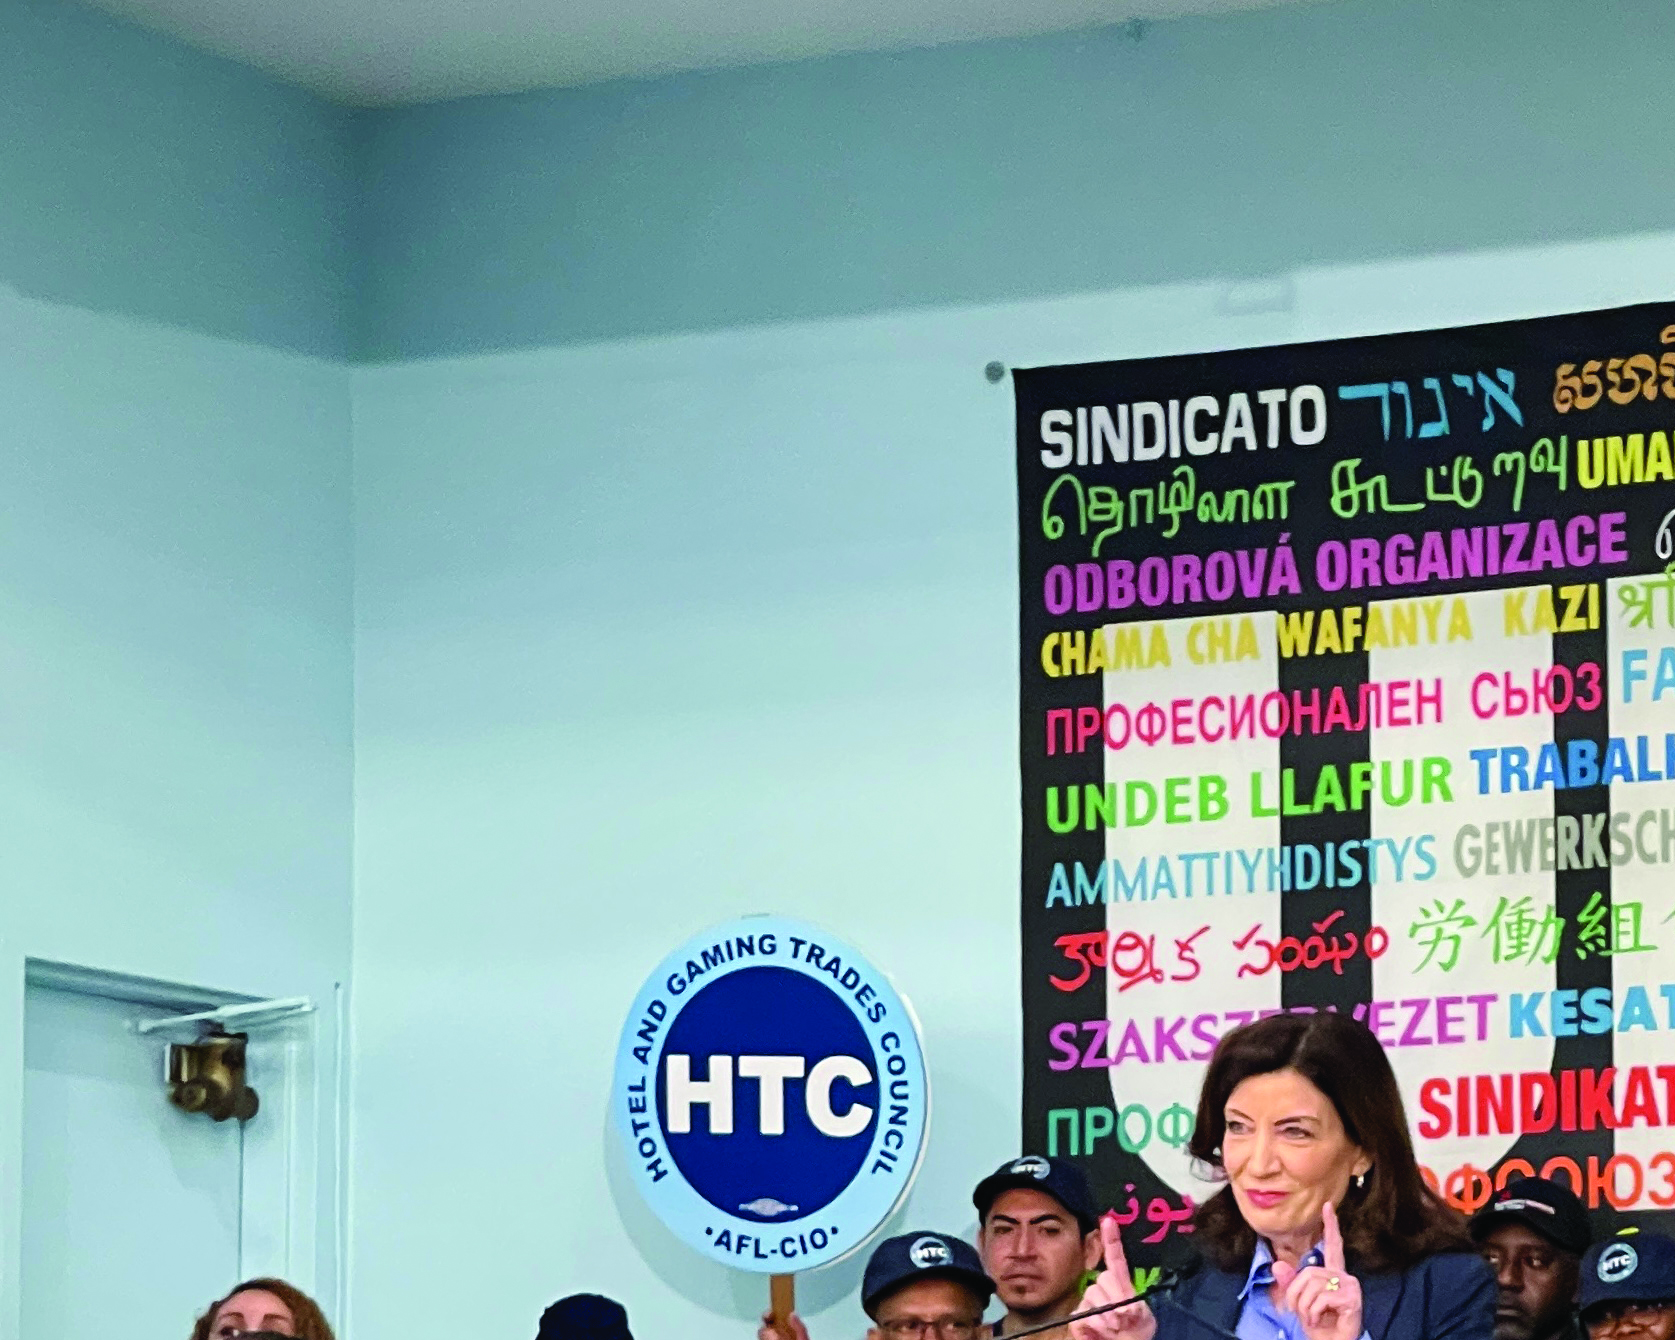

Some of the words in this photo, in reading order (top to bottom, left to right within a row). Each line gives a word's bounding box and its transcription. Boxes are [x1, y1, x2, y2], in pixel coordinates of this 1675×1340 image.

[1040, 384, 1327, 469] SINDICATO
[1043, 536, 1302, 616] ODBOROVÁ
[1314, 512, 1629, 592] ORGANIZACE
[1041, 624, 1172, 678] CHAMA
[1186, 616, 1260, 669] CHA
[1277, 594, 1472, 658] WAFANYA
[1503, 583, 1601, 635] KAZI
[1046, 676, 1443, 757] ПРОФЕСИОНАЛЕН
[1045, 774, 1229, 834] UNDEB
[1250, 756, 1455, 819] LLAFUR
[1045, 834, 1437, 908] AMMATTIYHDISTYS
[666, 933, 779, 997] GAMING
[789, 936, 887, 1024] TRADES
[632, 998, 667, 1065] AND
[627, 1075, 669, 1183] HOTEL
[665, 1053, 875, 1139] HTC
[870, 1030, 910, 1177] COUNCIL
[713, 1226, 830, 1260] AFL-CIO
